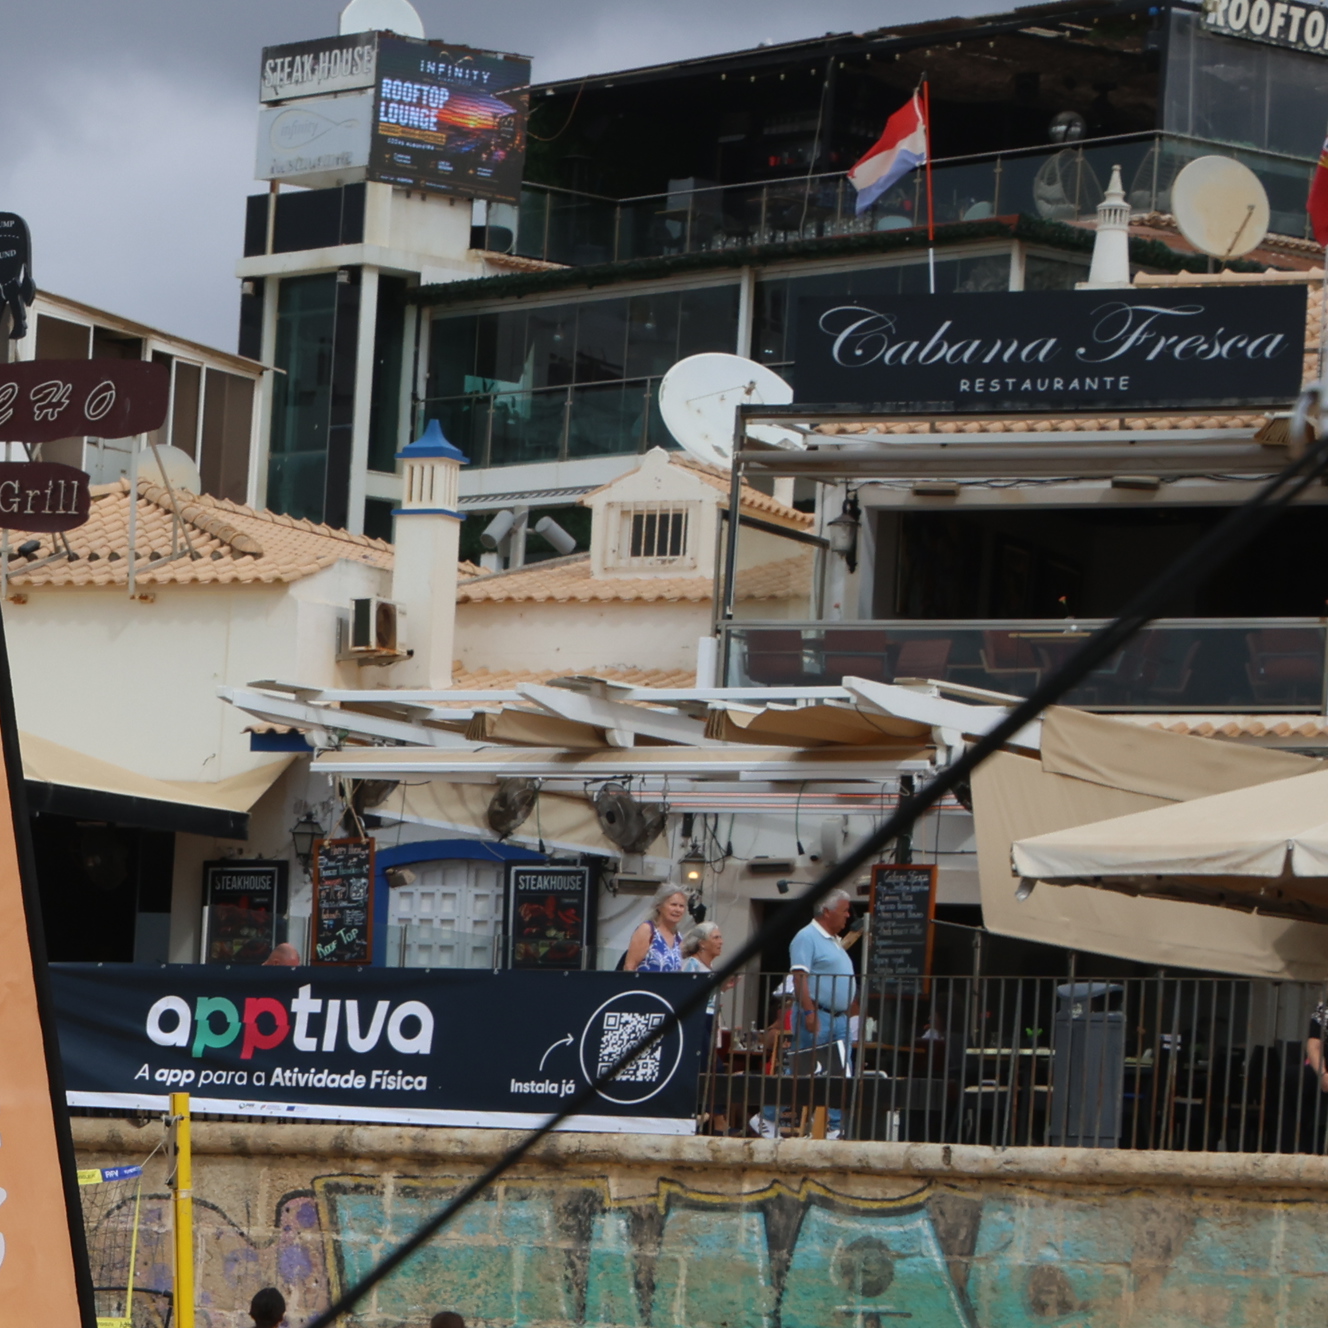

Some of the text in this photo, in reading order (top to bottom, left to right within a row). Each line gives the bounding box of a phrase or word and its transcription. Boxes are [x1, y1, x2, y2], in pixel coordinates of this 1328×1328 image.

[1206, 0, 1328, 50] ROOFTO
[265, 45, 372, 87] STEAK HOUSE
[420, 60, 491, 84] INFINITY
[381, 77, 450, 109] ROOFTOP
[379, 101, 439, 131] LOUNGE
[819, 302, 1290, 367] Cabana Fresca
[959, 376, 1131, 393] RESTAURANTE
[215, 875, 272, 891] STEAKHOUSE
[518, 875, 583, 891] STEAKHOUSE
[145, 983, 435, 1060] apptiva
[134, 1064, 428, 1092] A app para a Atividade Física
[510, 1079, 576, 1098] Instala já
